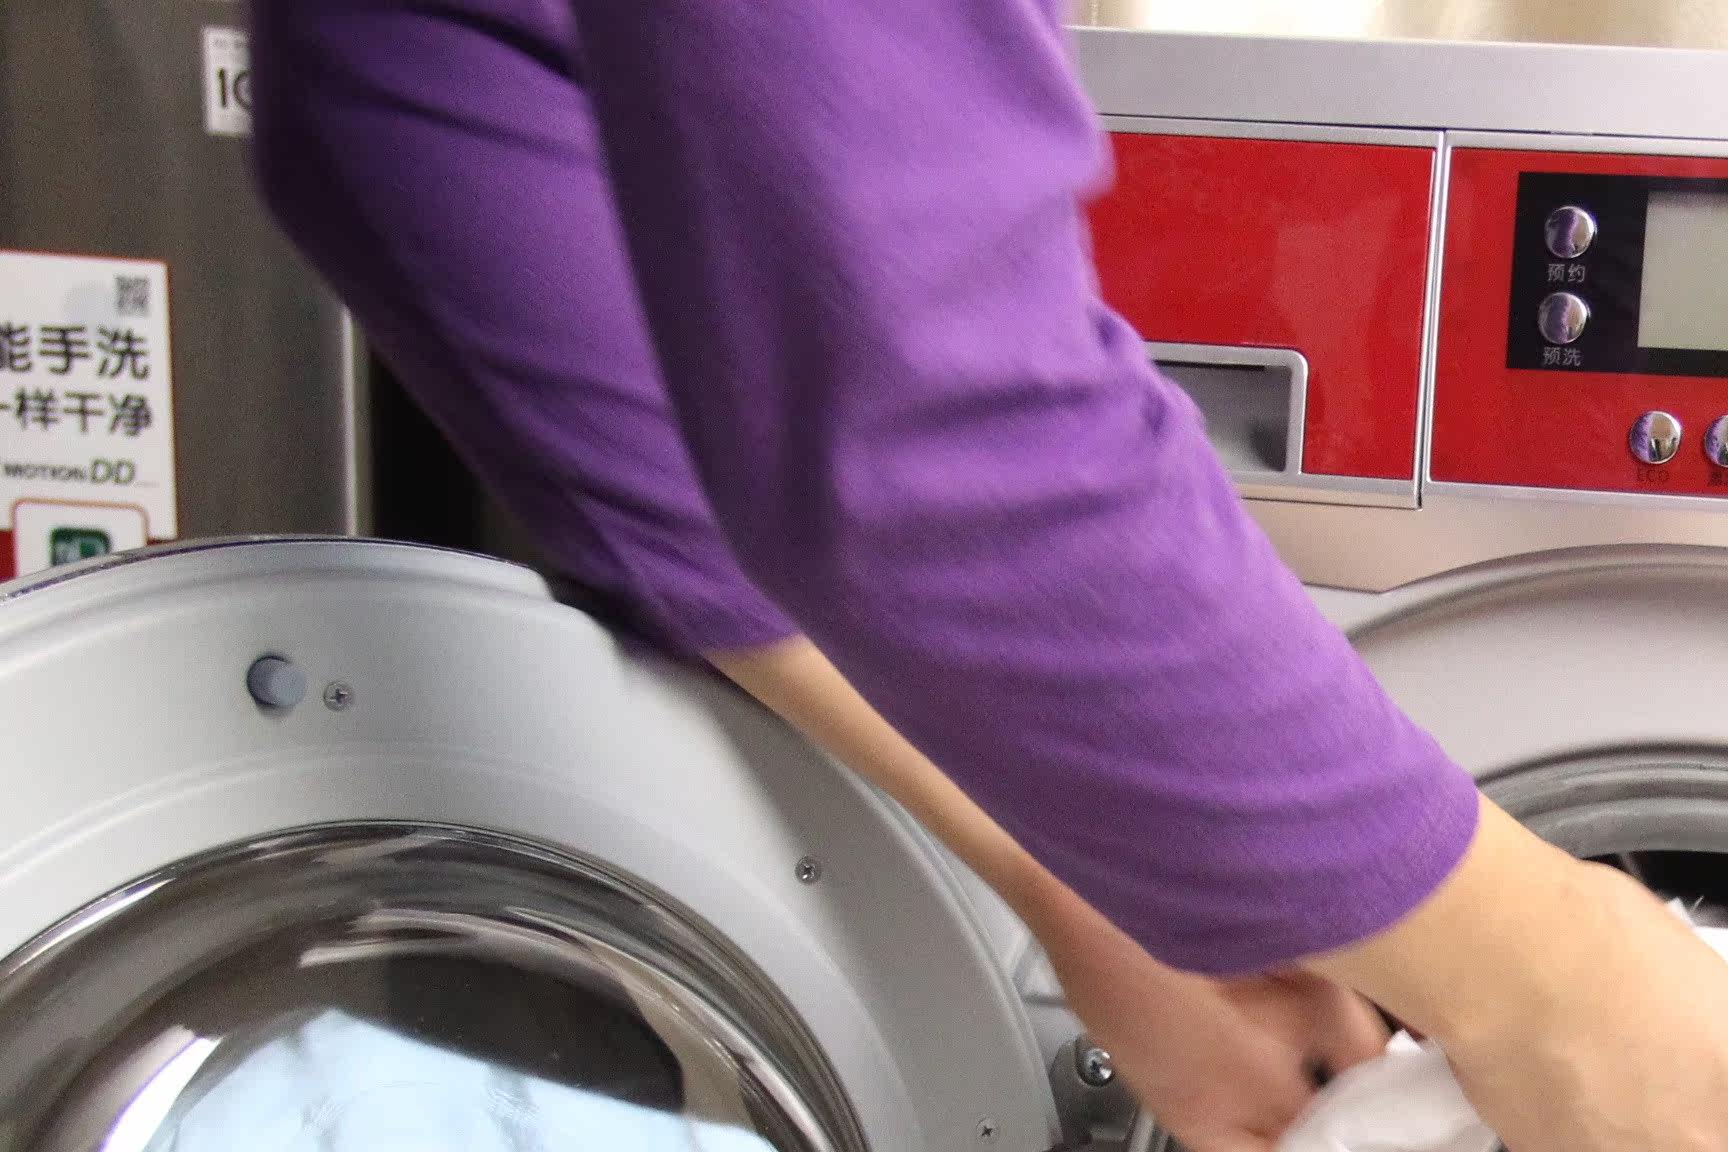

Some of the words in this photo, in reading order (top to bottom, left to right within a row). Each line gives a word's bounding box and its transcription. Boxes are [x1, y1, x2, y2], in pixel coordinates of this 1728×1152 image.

[1547, 263, 1586, 283] 预约
[1543, 346, 1581, 367] 预洗
[0, 386, 152, 437] 样干净
[90, 458, 136, 486] DD
[1636, 466, 1670, 483] ECO
